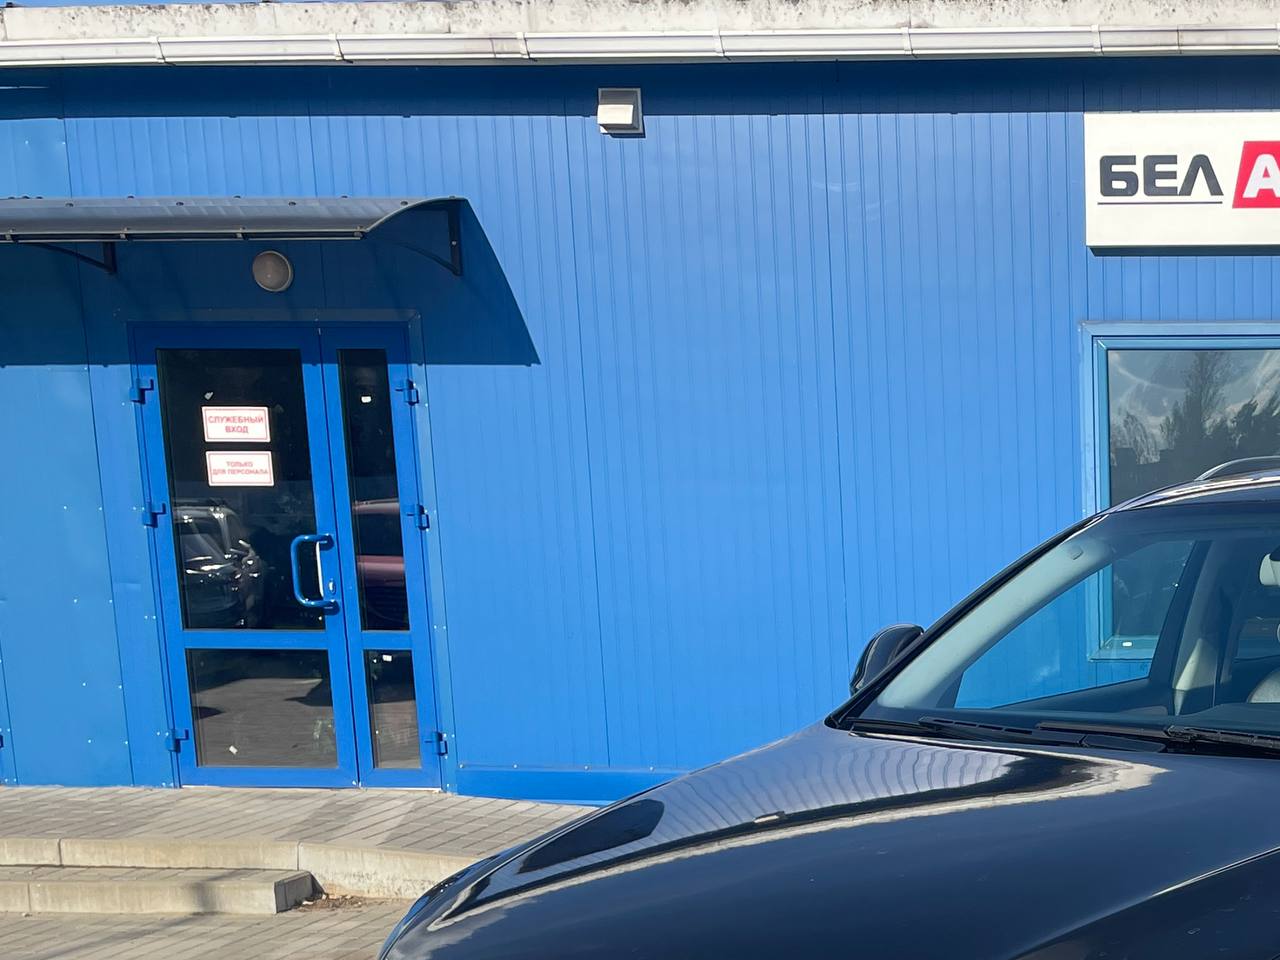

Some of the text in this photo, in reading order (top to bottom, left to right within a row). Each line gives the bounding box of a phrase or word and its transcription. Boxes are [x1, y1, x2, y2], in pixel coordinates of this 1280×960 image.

[1098, 154, 1224, 197] БЕЛ
[208, 415, 264, 424] СЛУЖЕБНЫЙ
[225, 425, 249, 434] ВХОД
